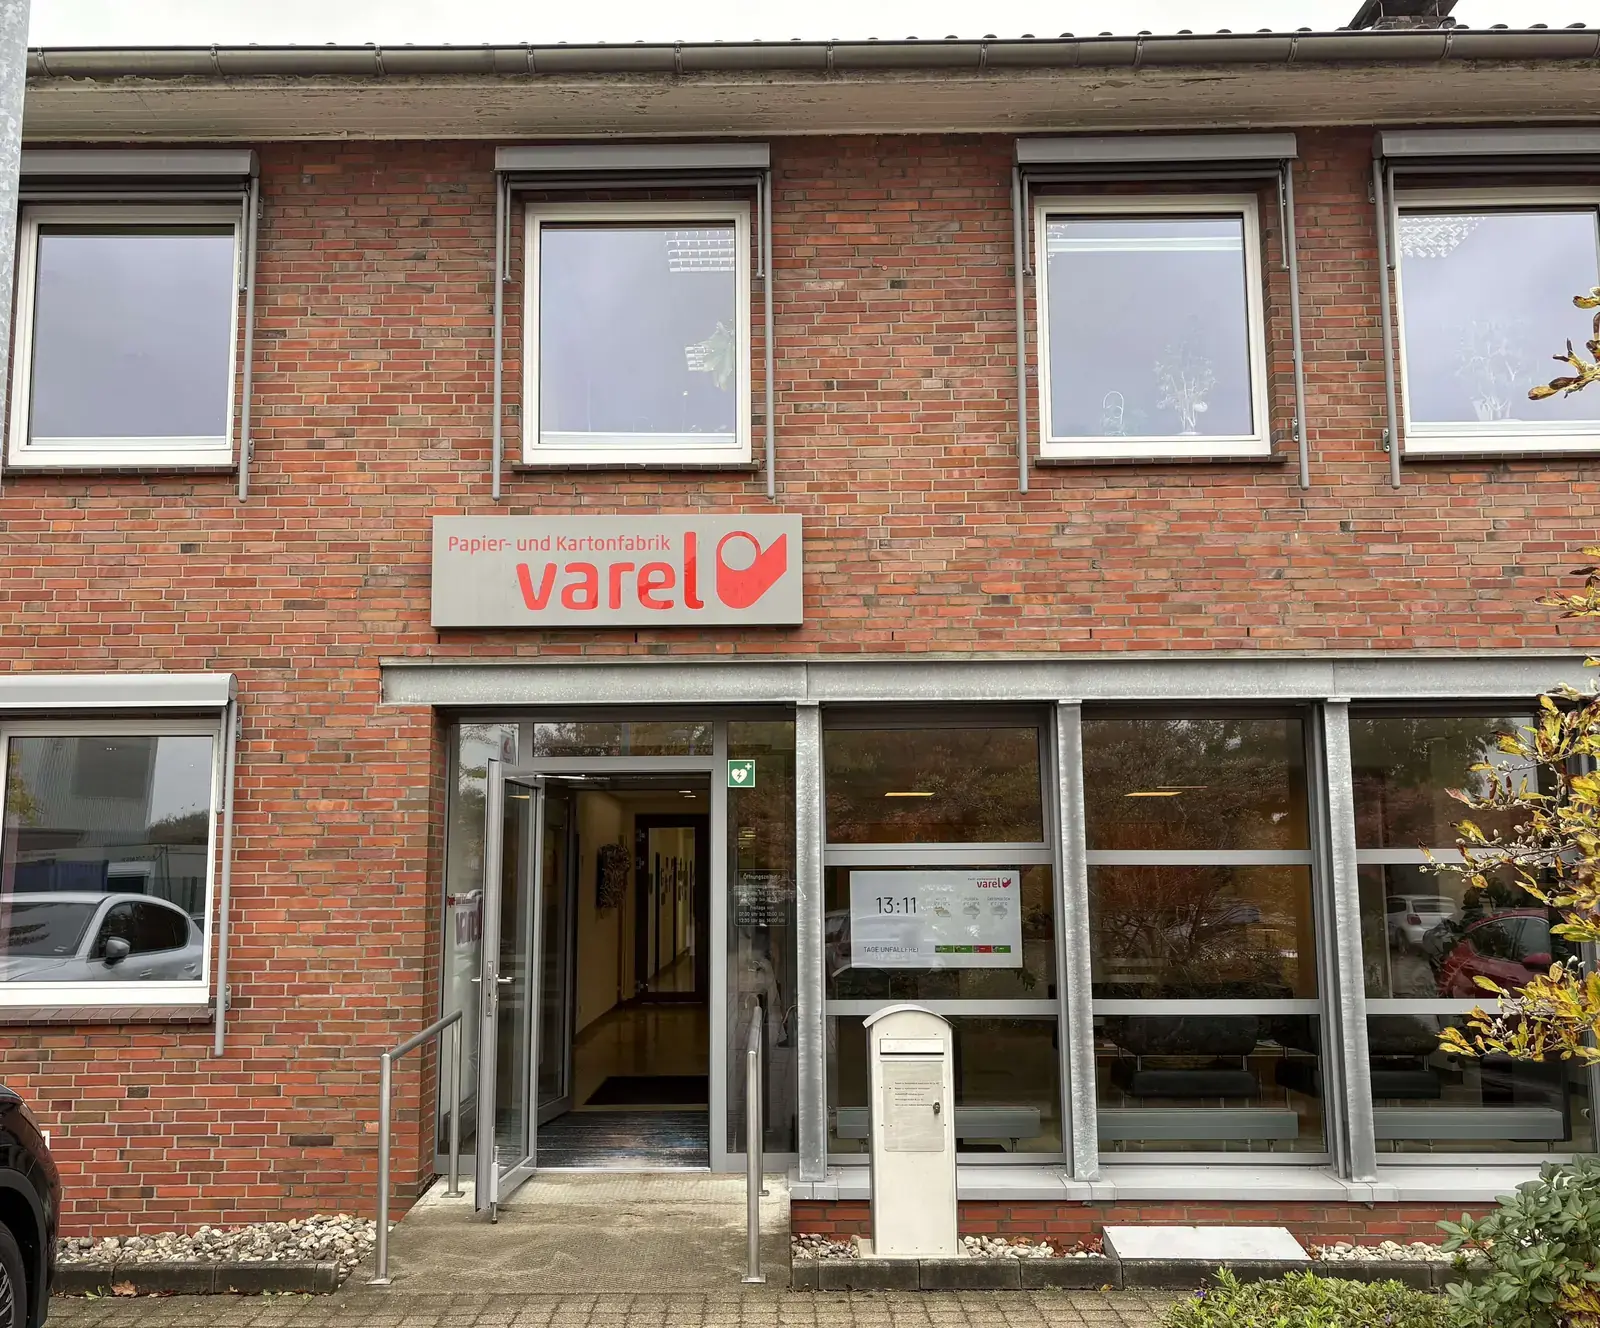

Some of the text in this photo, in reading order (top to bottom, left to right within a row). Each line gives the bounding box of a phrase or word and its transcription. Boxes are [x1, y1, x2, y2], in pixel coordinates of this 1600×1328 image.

[448, 535, 671, 555] Papier- und Kartonfabrik
[516, 531, 704, 611] varel
[976, 877, 1001, 888] varel
[876, 897, 917, 914] 13:11
